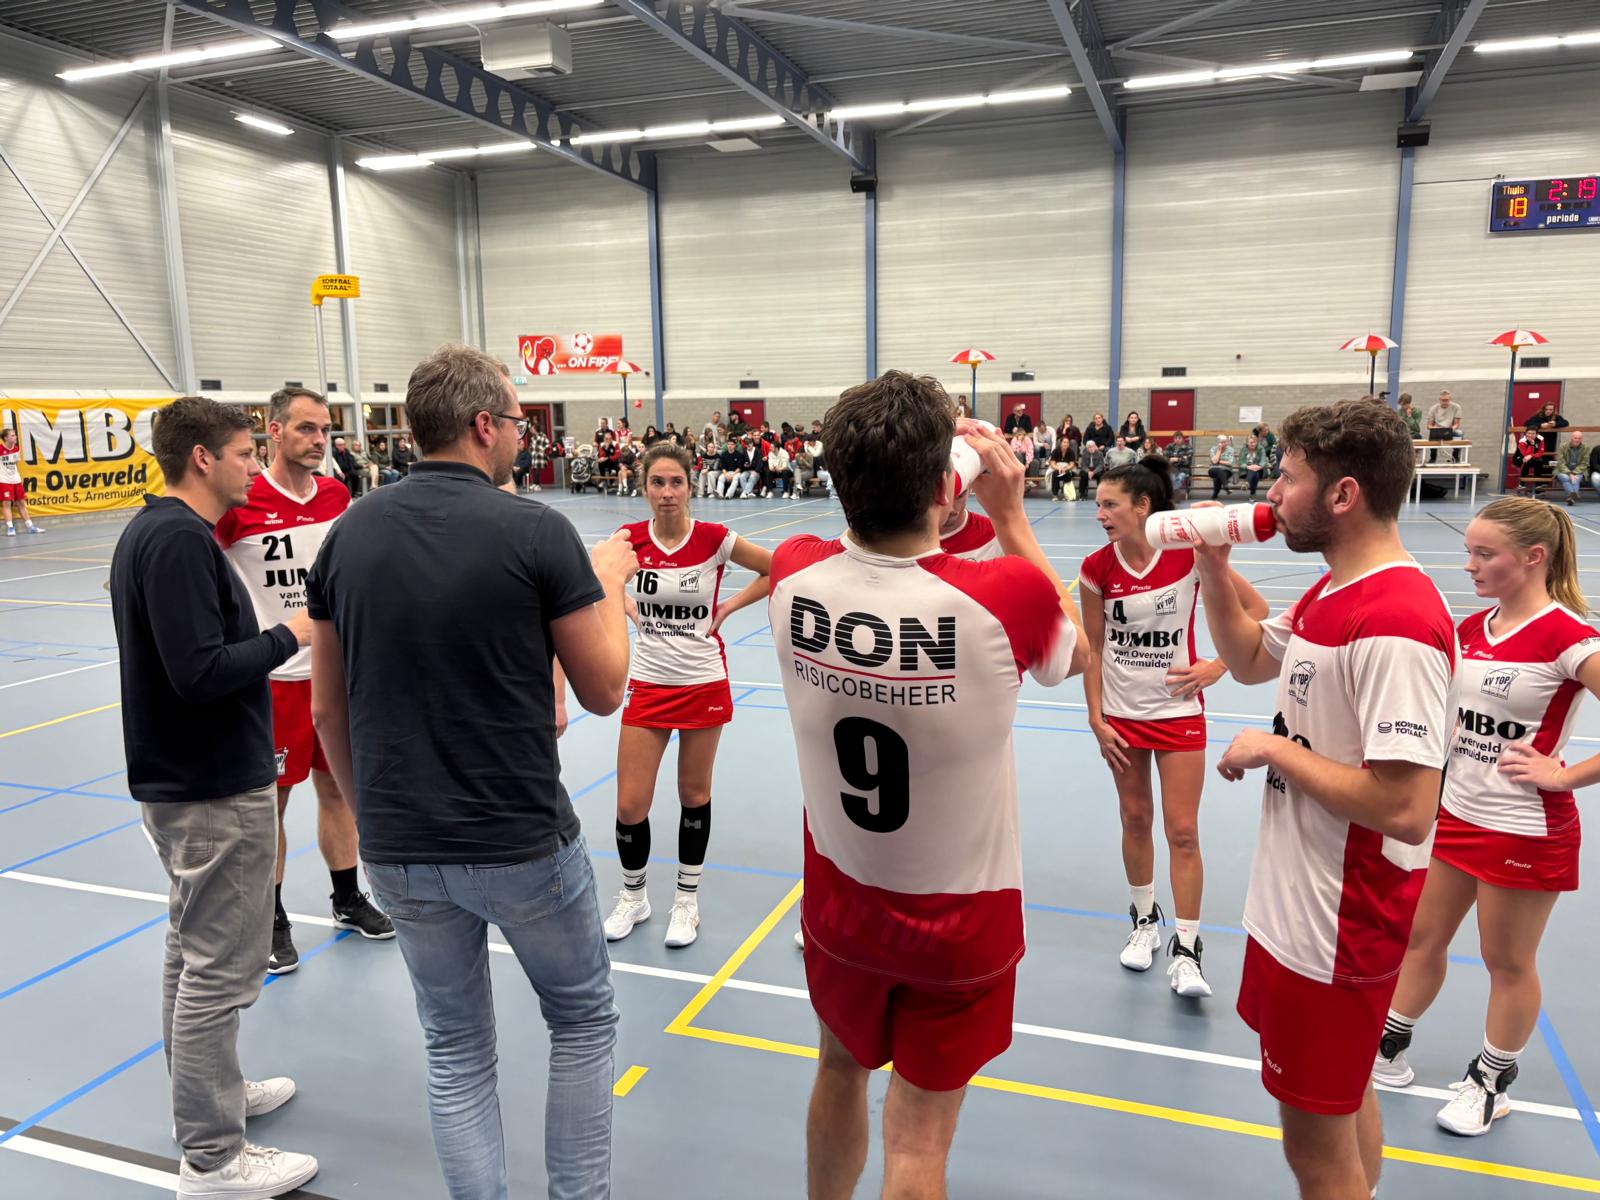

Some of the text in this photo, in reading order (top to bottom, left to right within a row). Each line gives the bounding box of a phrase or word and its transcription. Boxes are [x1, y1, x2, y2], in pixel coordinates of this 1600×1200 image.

[1503, 186, 1525, 195] Thuis
[1509, 197, 1528, 217] 18
[1546, 213, 1580, 224] periode
[568, 357, 588, 368] ON
[46, 463, 147, 491] Overveld
[73, 494, 81, 504] 5,
[262, 534, 294, 561] 21
[636, 570, 659, 595] 16
[280, 591, 300, 599] van
[1156, 596, 1176, 610] KV TOP
[1112, 599, 1128, 625] 4
[655, 621, 696, 631] Overveld
[790, 595, 956, 671] DON
[1113, 648, 1174, 660] van Overveld
[793, 660, 957, 706] RISICOBEHEER
[1483, 676, 1511, 686] KV TOP
[1394, 720, 1429, 732] KORFBAL
[1394, 727, 1423, 738] TOTAAL
[1459, 736, 1501, 753] verveld
[833, 716, 910, 833] 9
